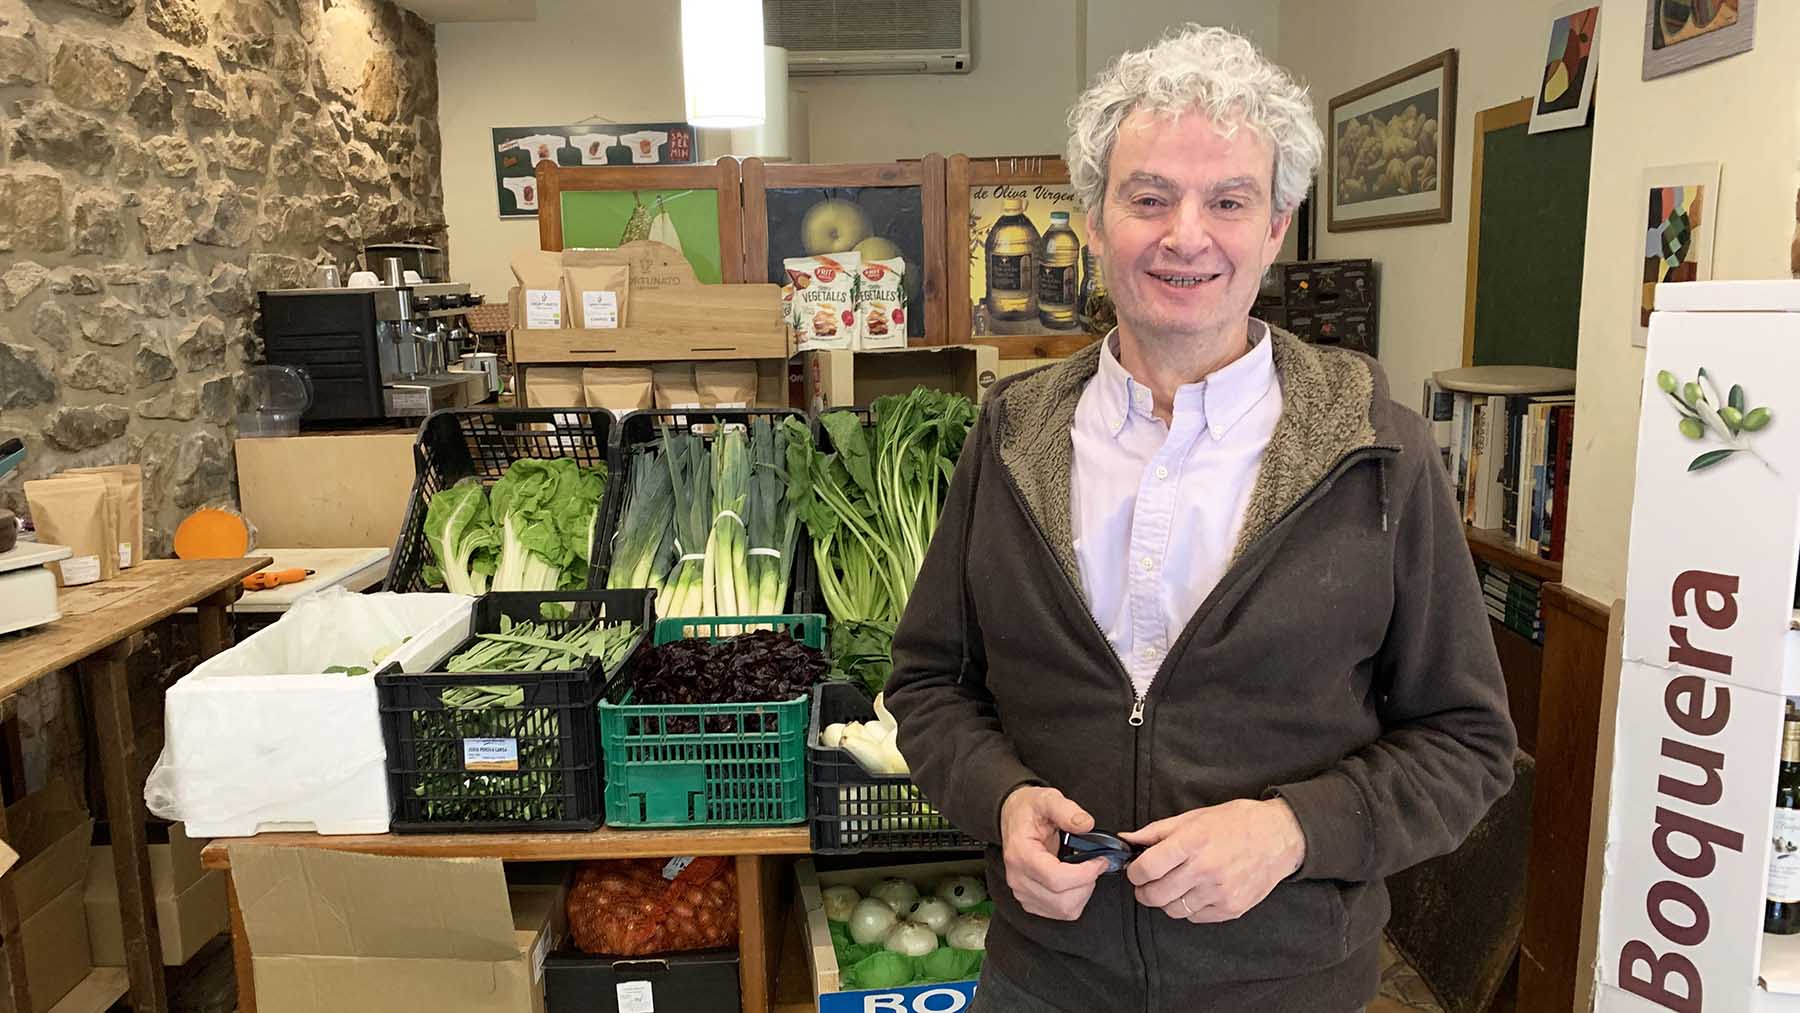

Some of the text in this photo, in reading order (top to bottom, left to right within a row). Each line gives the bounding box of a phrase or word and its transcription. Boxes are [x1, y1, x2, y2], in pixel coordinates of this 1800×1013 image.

[671, 132, 688, 141] SAN
[671, 141, 688, 149] FER
[670, 149, 688, 158] MIN
[974, 187, 989, 200] de
[993, 185, 1027, 200] Oliva
[1033, 185, 1076, 204] Virgen
[802, 290, 847, 303] VEGETALES
[859, 289, 897, 303] EGETALES
[1618, 568, 1744, 1013] Boquera
[864, 985, 978, 1013] BO
